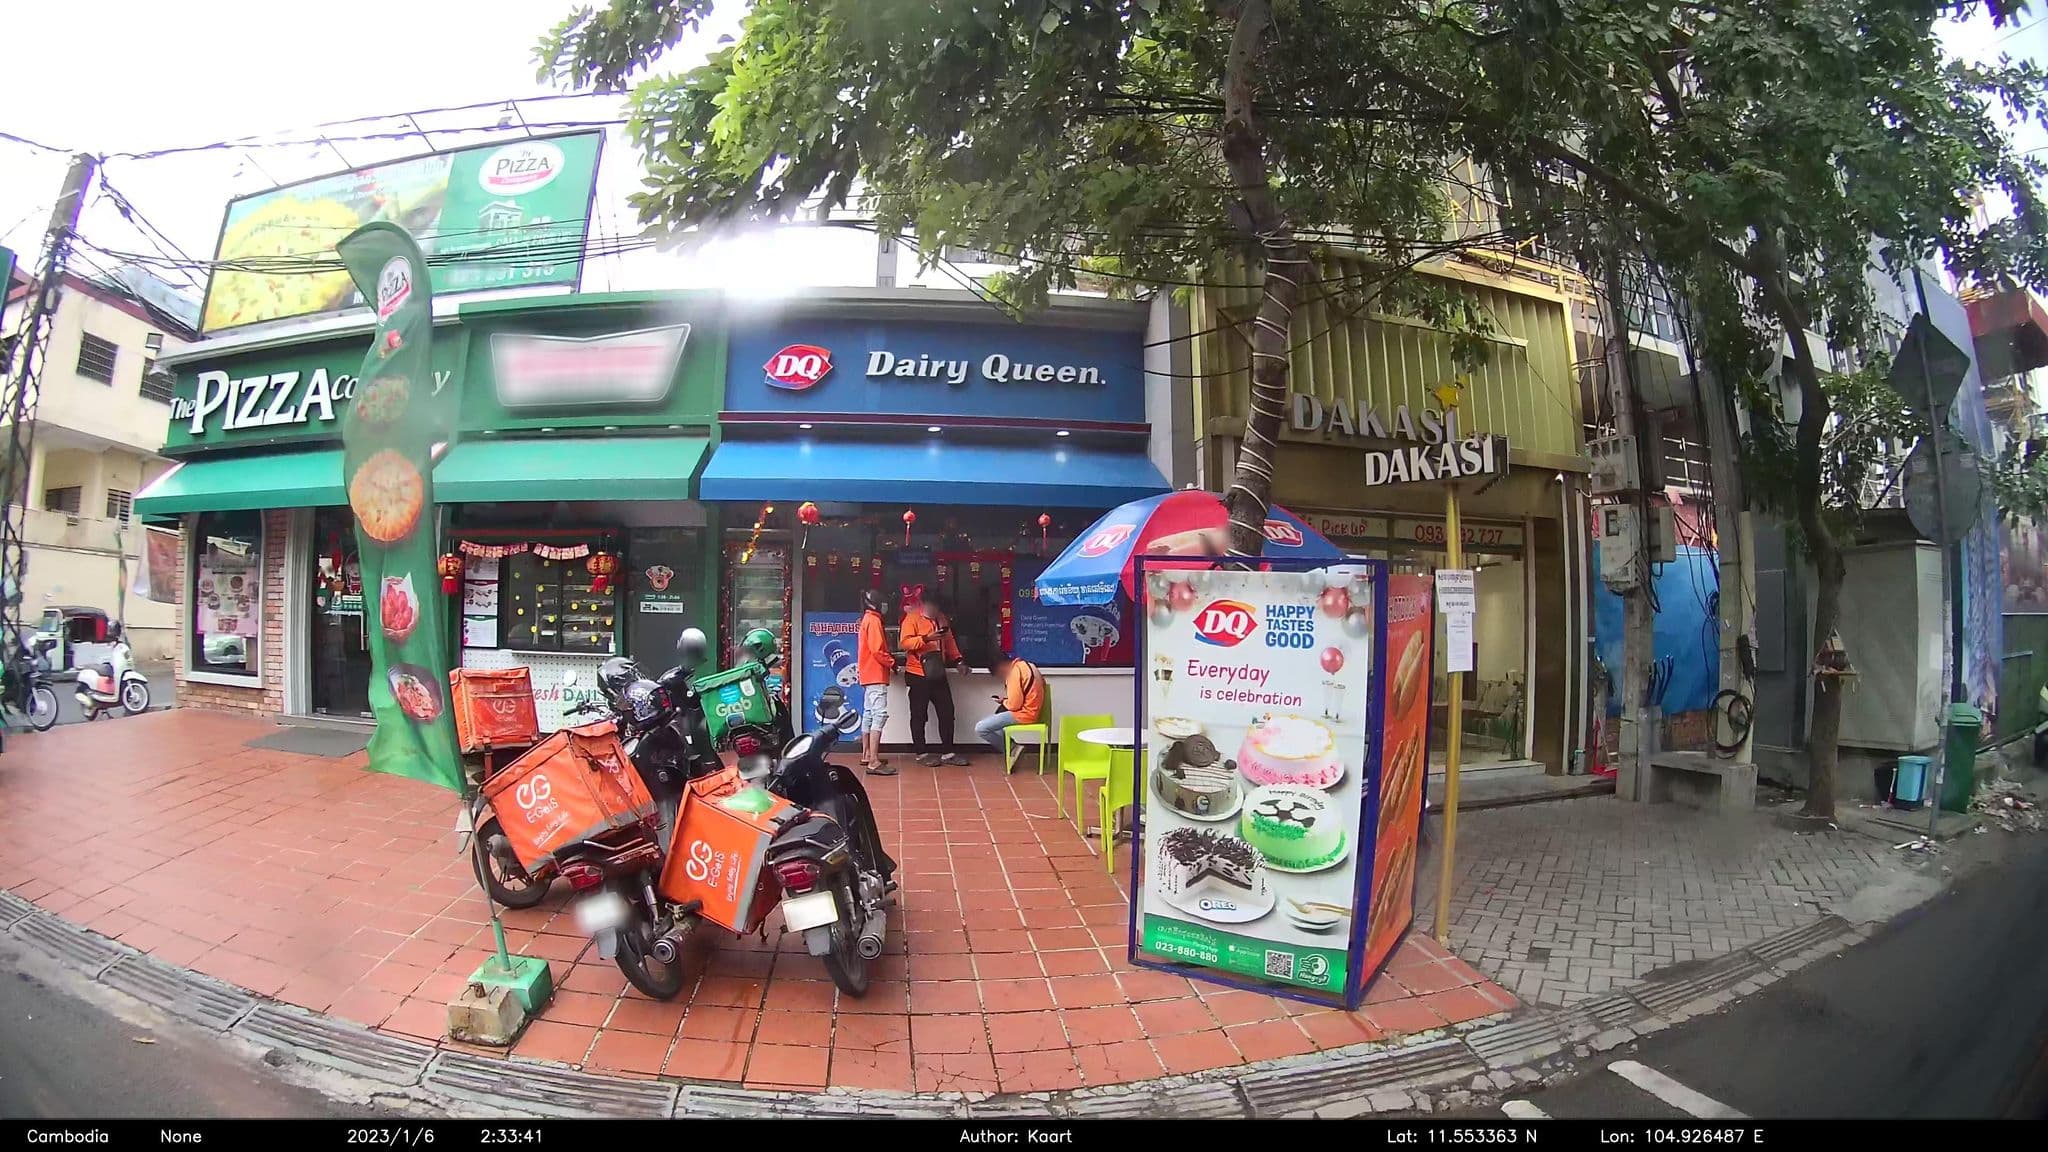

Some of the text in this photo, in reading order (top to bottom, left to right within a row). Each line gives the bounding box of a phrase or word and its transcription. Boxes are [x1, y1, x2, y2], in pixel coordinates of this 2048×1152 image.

[495, 157, 550, 176] PIZZA
[775, 354, 821, 380] DQ
[866, 351, 968, 384] Dairy
[171, 397, 196, 420] The
[189, 368, 335, 434] PIZZA
[1294, 392, 1456, 446] DAKASI
[1365, 434, 1494, 486] DAKASI
[1478, 528, 1504, 545] 727
[1266, 605, 1315, 620] HAPPY
[1203, 610, 1249, 639] DQ
[1266, 619, 1314, 632] TASTES
[1265, 632, 1315, 649] GOOD
[1188, 659, 1270, 687] Everyday
[563, 687, 605, 702] DAIL
[1200, 687, 1302, 707] is celebration
[715, 697, 752, 717] Grab
[1199, 898, 1237, 911] OREO
[1155, 941, 1218, 964] 023-880-880
